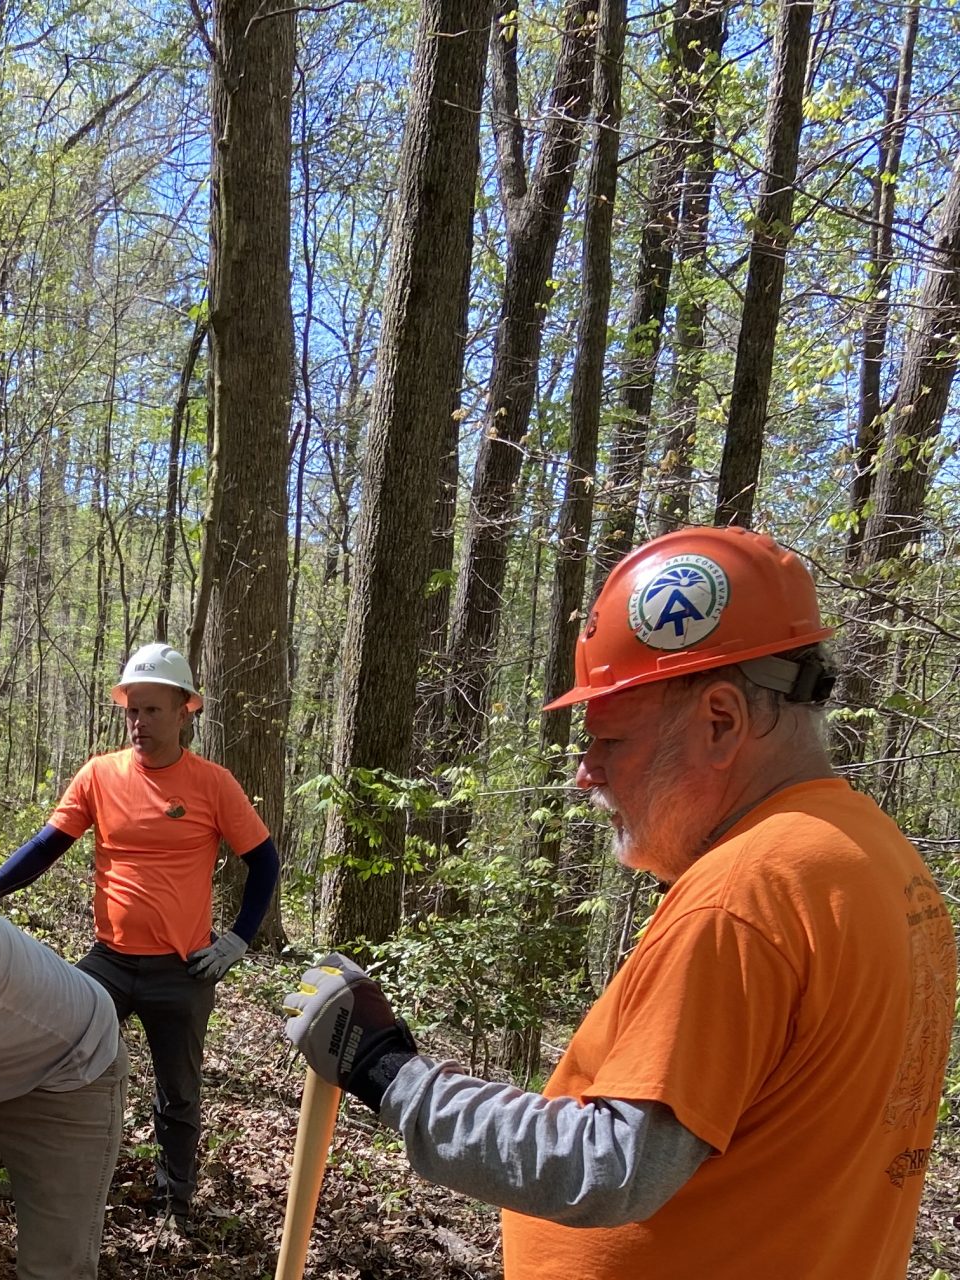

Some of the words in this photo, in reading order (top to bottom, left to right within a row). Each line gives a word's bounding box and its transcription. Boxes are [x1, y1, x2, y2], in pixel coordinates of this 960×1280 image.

[695, 558, 725, 621] CONSERVANCY
[328, 1007, 350, 1057] PURPOSE
[340, 1024, 364, 1074] GENERAL
